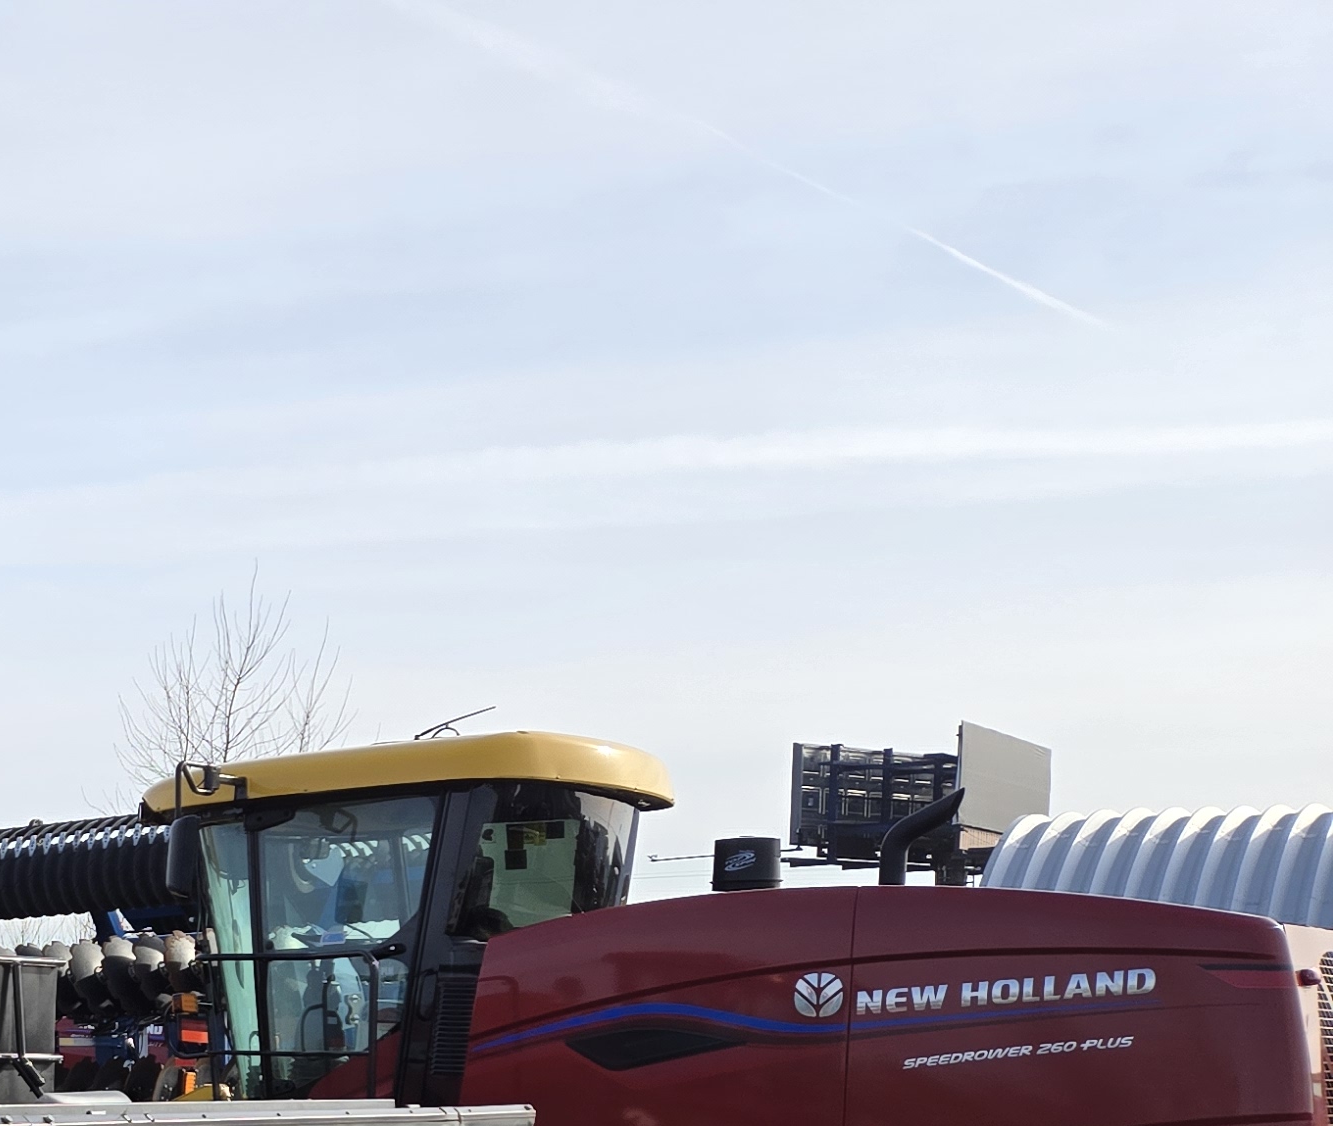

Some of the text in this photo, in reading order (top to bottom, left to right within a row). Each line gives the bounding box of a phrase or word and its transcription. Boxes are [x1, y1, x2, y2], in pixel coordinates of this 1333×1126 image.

[856, 967, 1157, 1016] NEW HOLLAND
[902, 1045, 1033, 1070] SPEEDROWER
[1036, 1040, 1077, 1056] 260
